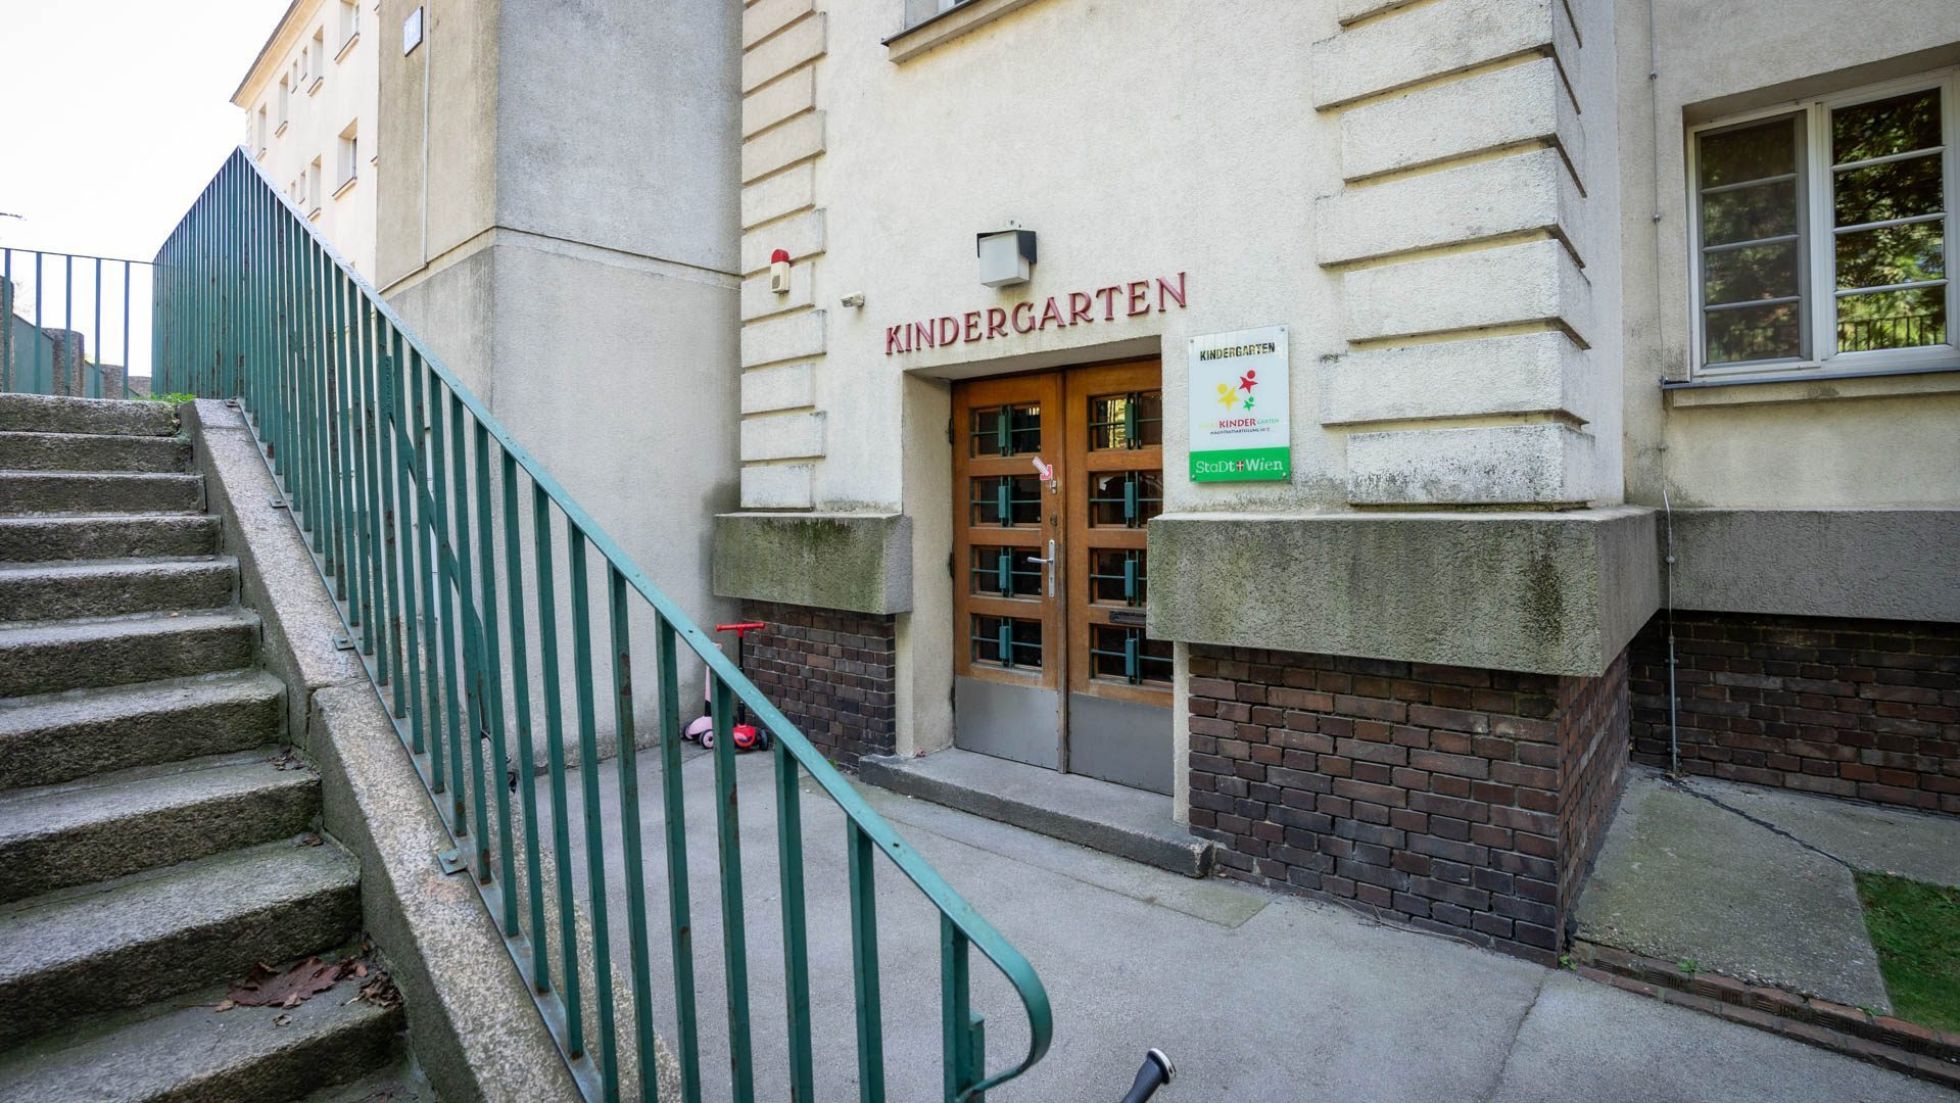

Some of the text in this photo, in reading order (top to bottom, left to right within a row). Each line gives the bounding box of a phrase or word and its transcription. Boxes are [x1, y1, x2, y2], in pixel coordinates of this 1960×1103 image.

[886, 272, 1187, 354] KINDERGARTEN
[1200, 342, 1276, 361] KINDERGARTEN
[1219, 418, 1256, 428] KINDER
[1245, 457, 1284, 471] Wien
